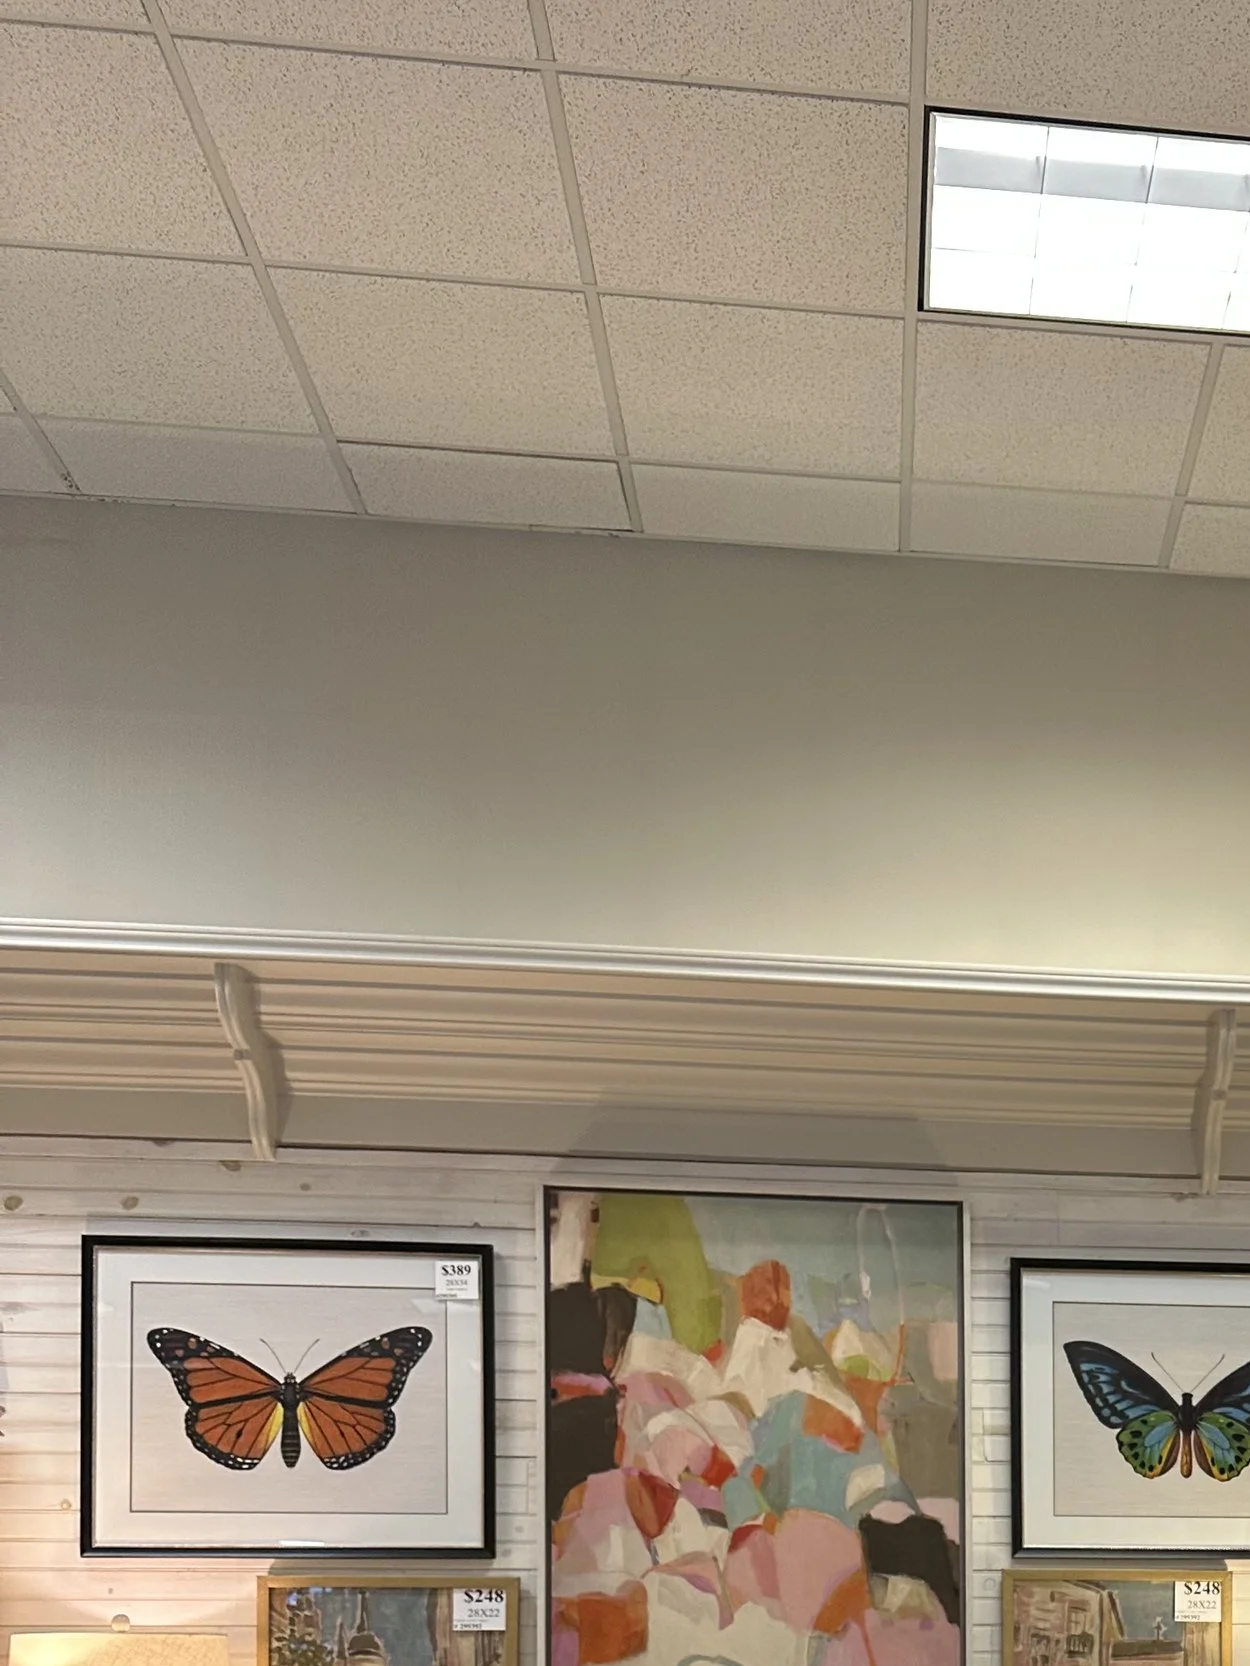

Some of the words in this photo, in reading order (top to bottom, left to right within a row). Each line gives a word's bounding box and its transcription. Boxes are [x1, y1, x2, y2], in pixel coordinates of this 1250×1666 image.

[441, 1264, 472, 1277] $389
[1183, 1580, 1220, 1596] $248
[464, 1588, 504, 1604] $248
[1187, 1600, 1217, 1610] 28X22
